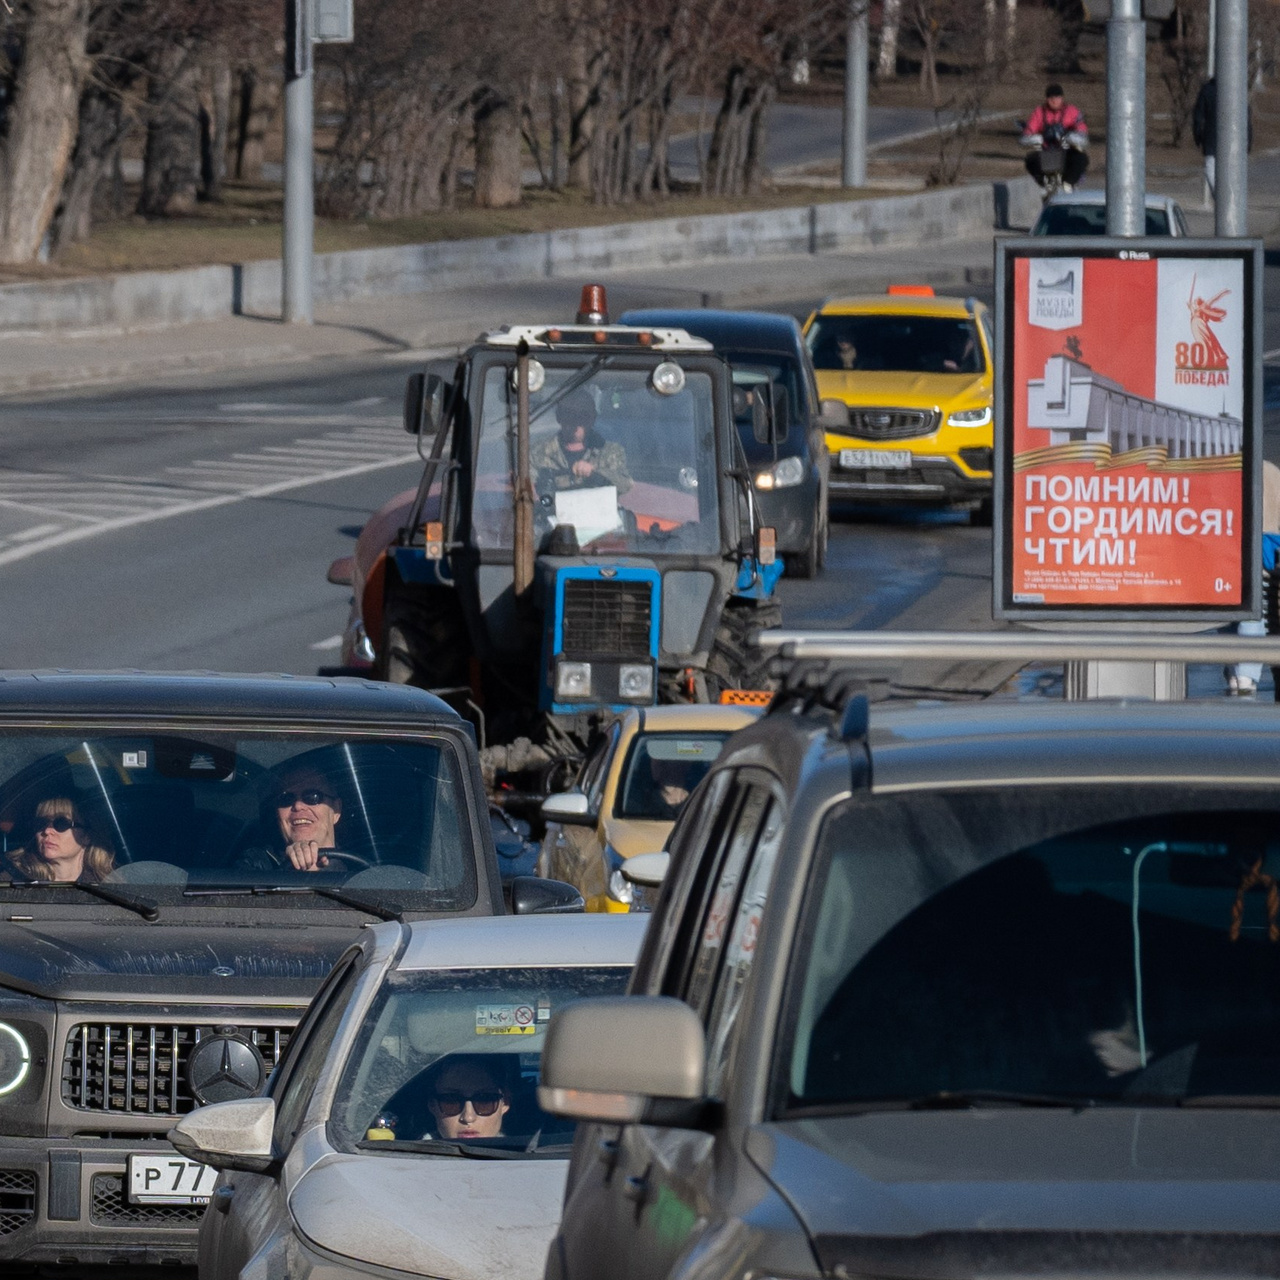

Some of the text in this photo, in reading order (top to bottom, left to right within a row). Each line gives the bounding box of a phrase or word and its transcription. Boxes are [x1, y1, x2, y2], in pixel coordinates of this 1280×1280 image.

[1036, 306, 1075, 318] ПОБЕДЫ
[1037, 296, 1075, 308] МУЗЕЙ
[1175, 342, 1205, 369] 80
[1174, 370, 1230, 388] ПОБЕДА!
[1025, 475, 1190, 503] ПОМНИМ!
[1024, 506, 1234, 538] ГОРДИМСЯ!
[1024, 537, 1136, 566] ЧТИМ!
[1214, 577, 1233, 593] 0+
